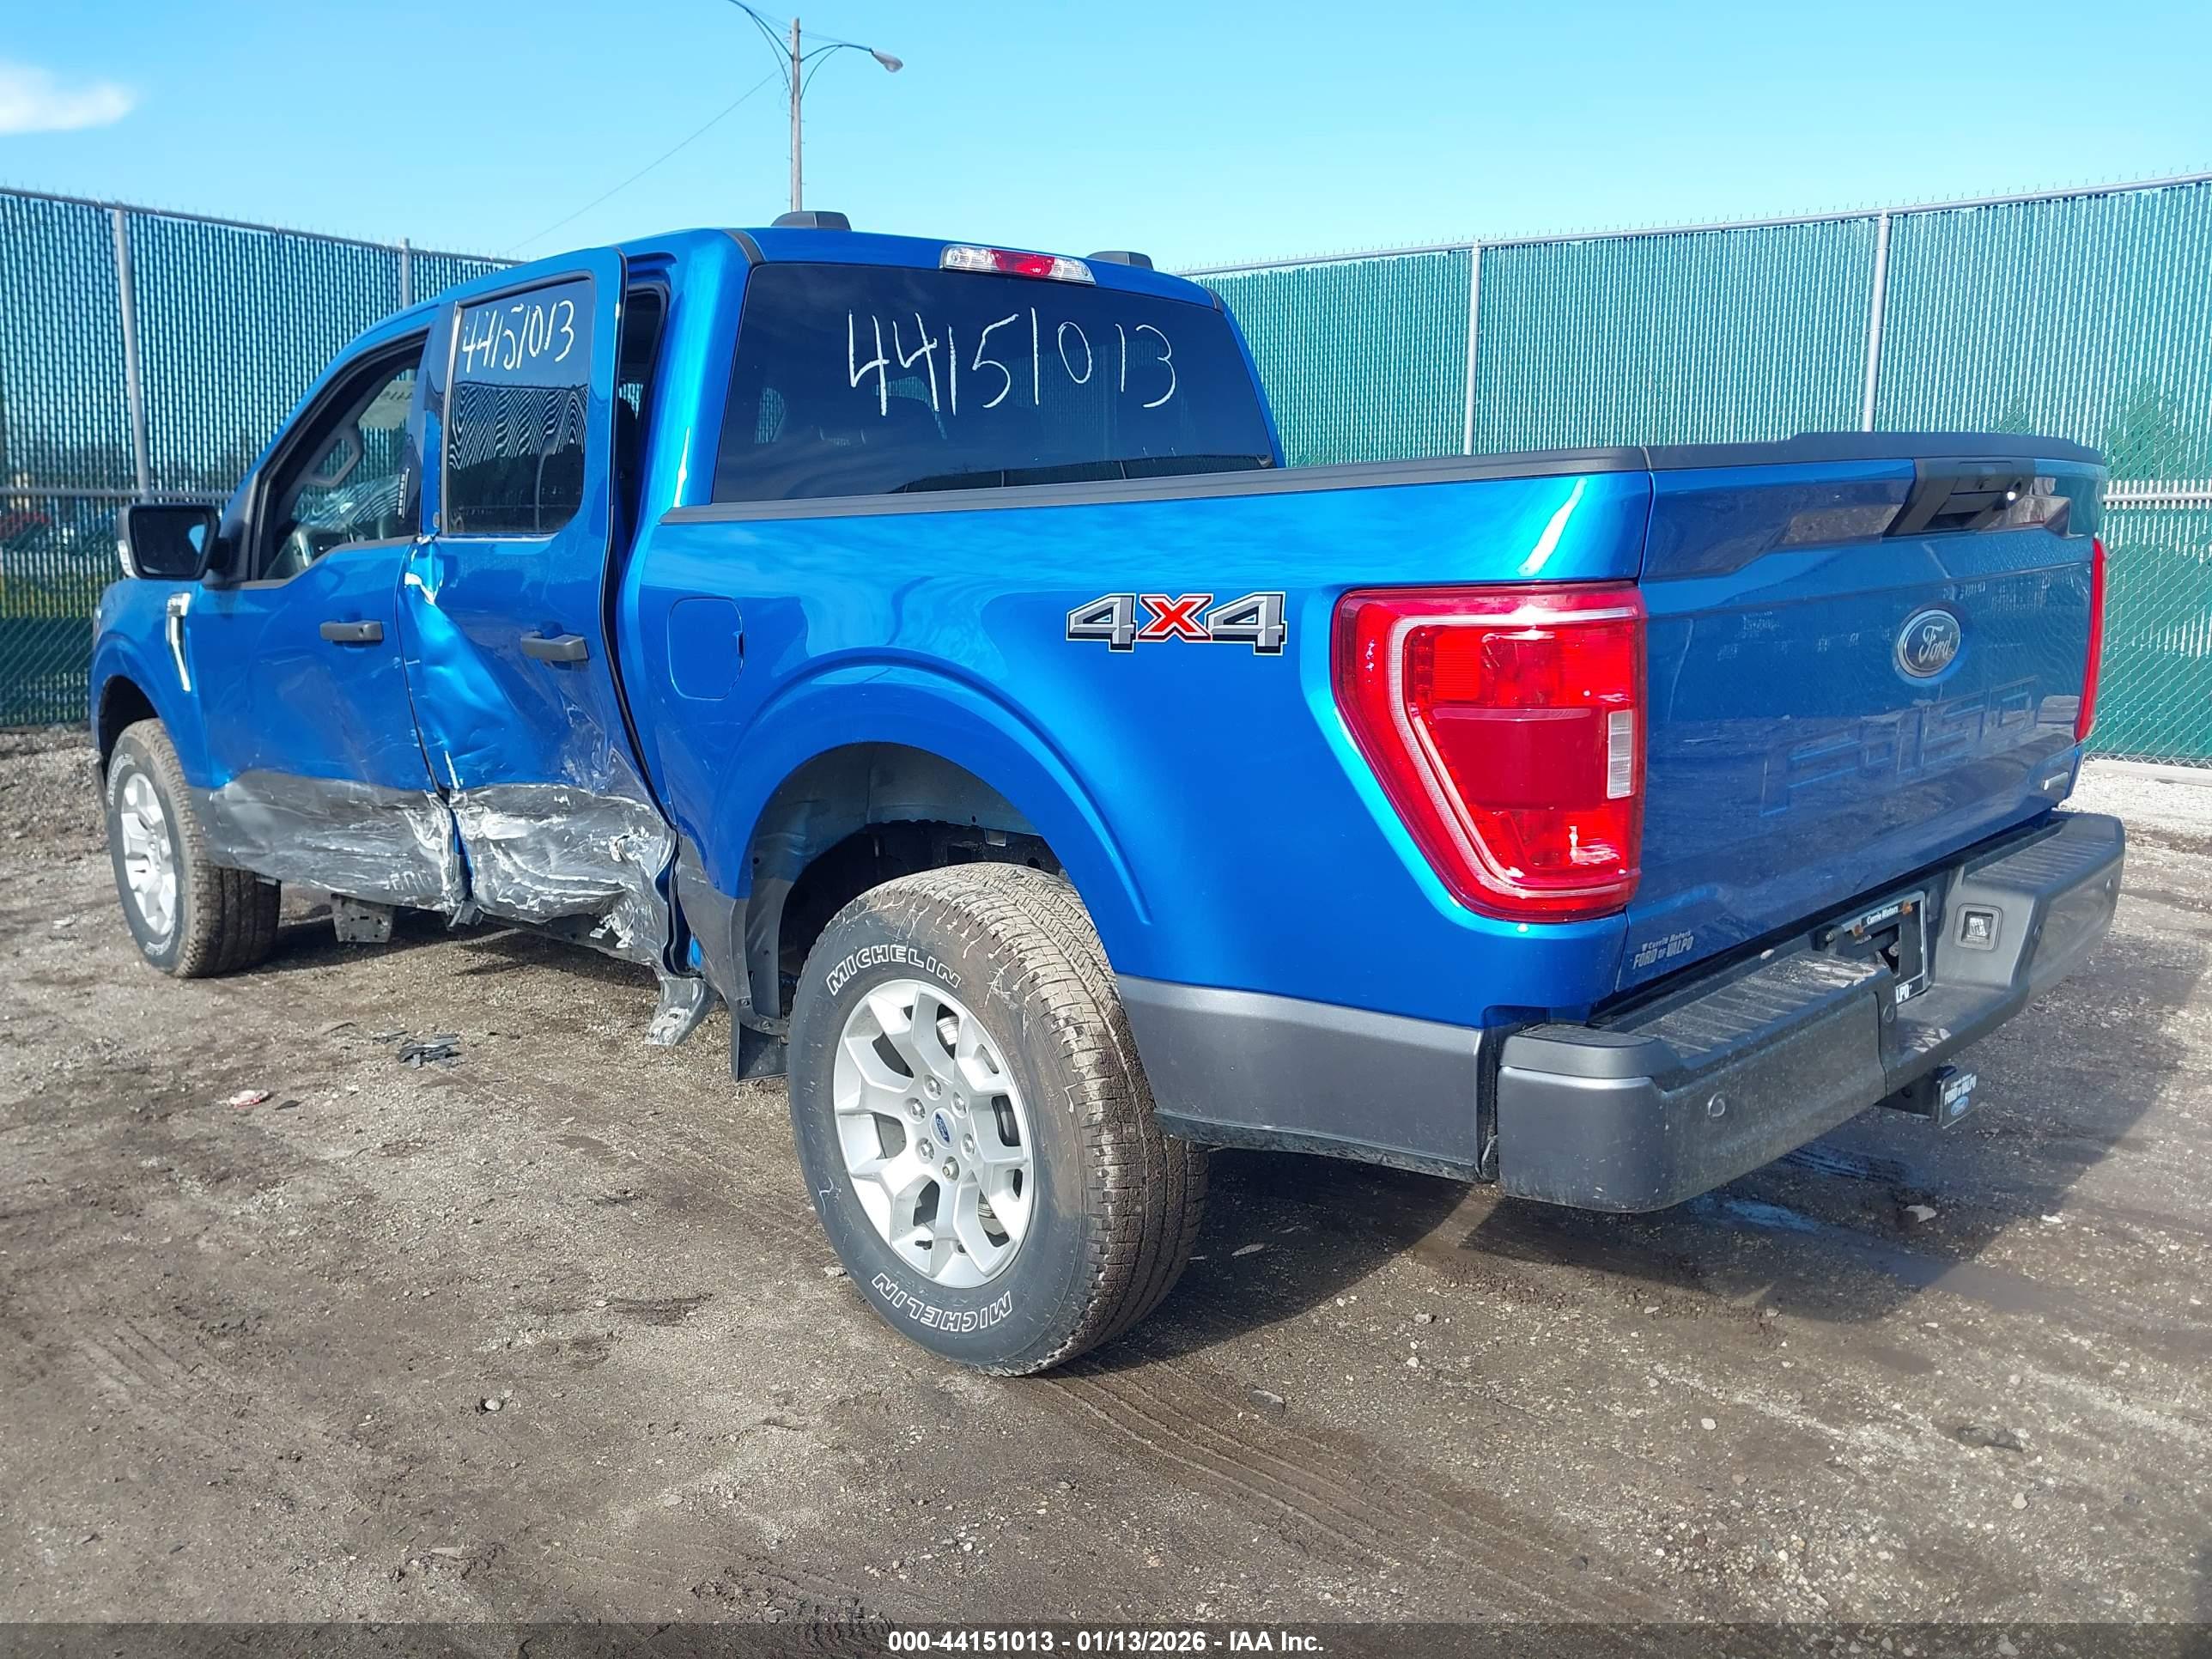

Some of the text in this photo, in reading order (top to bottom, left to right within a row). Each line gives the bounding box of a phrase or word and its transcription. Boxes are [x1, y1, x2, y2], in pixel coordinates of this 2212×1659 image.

[462, 300, 574, 374] 44151013
[848, 307, 1176, 416] 44151013
[1918, 625, 1953, 664] Ford
[1866, 906, 1899, 925] Currie Motors
[825, 944, 963, 996] MICHELIN
[1632, 948, 1658, 969] FORD
[1666, 935, 1694, 957] VALPO
[1895, 983, 1910, 1003] LPO
[872, 1273, 1012, 1332] MICHELIN
